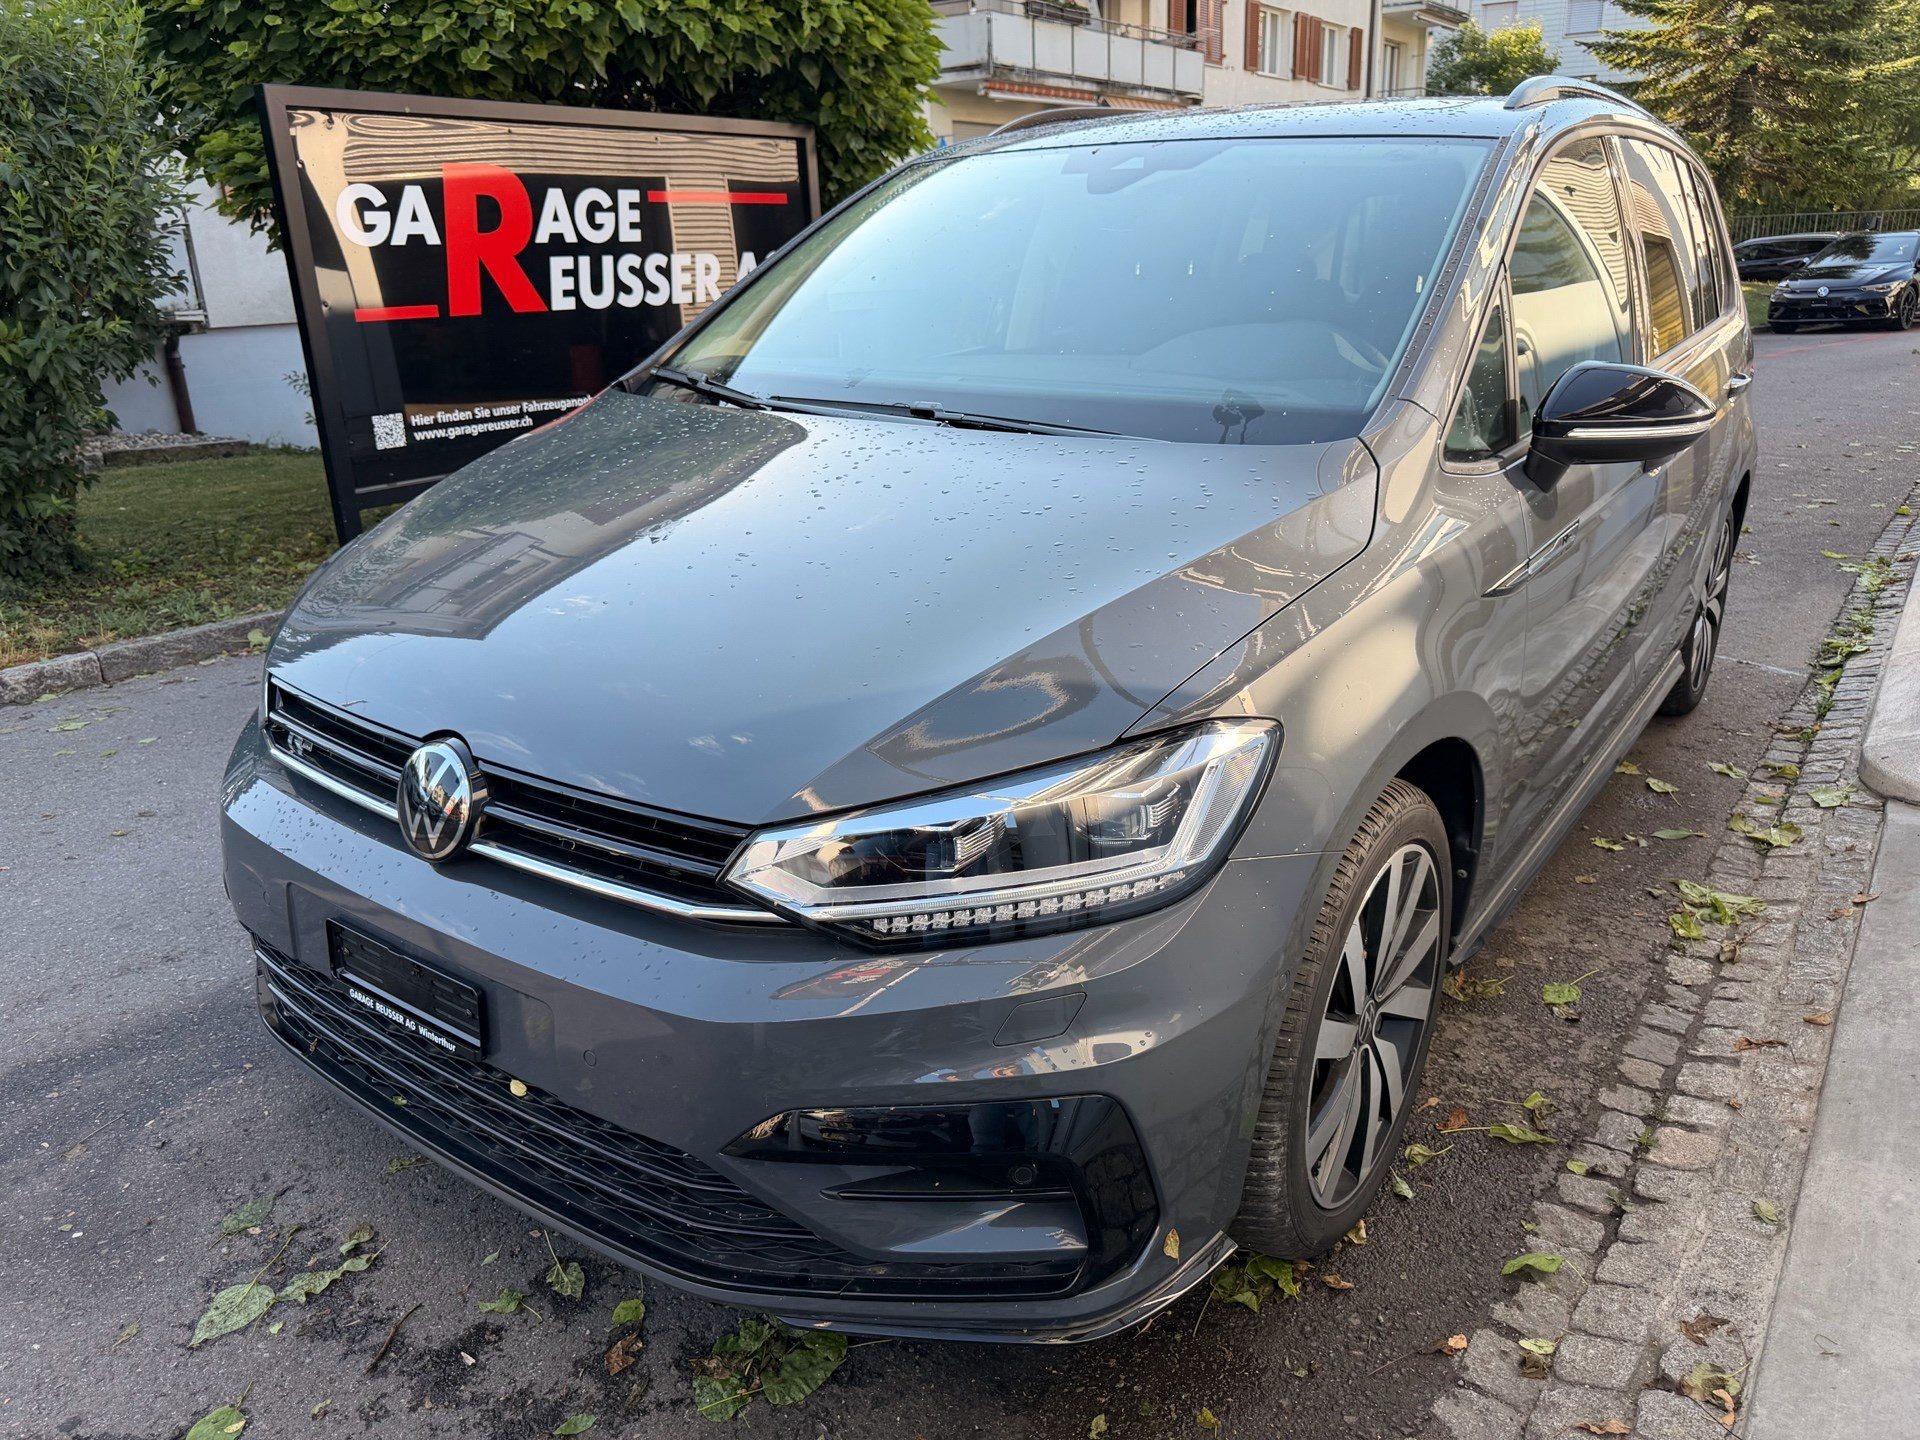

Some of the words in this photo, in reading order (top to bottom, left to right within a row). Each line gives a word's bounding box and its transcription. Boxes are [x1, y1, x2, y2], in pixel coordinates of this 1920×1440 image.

[336, 162, 642, 316] GARAGE
[410, 413, 434, 426] Hier
[436, 408, 472, 423] finden
[474, 406, 491, 419] Sie
[492, 404, 521, 415] unser
[413, 416, 533, 441] www.garagereusser.ch
[349, 988, 374, 1009] GARAGE
[375, 1002, 404, 1025] REUSSER
[405, 1018, 416, 1031] AG
[418, 1025, 456, 1052] Winterthur
